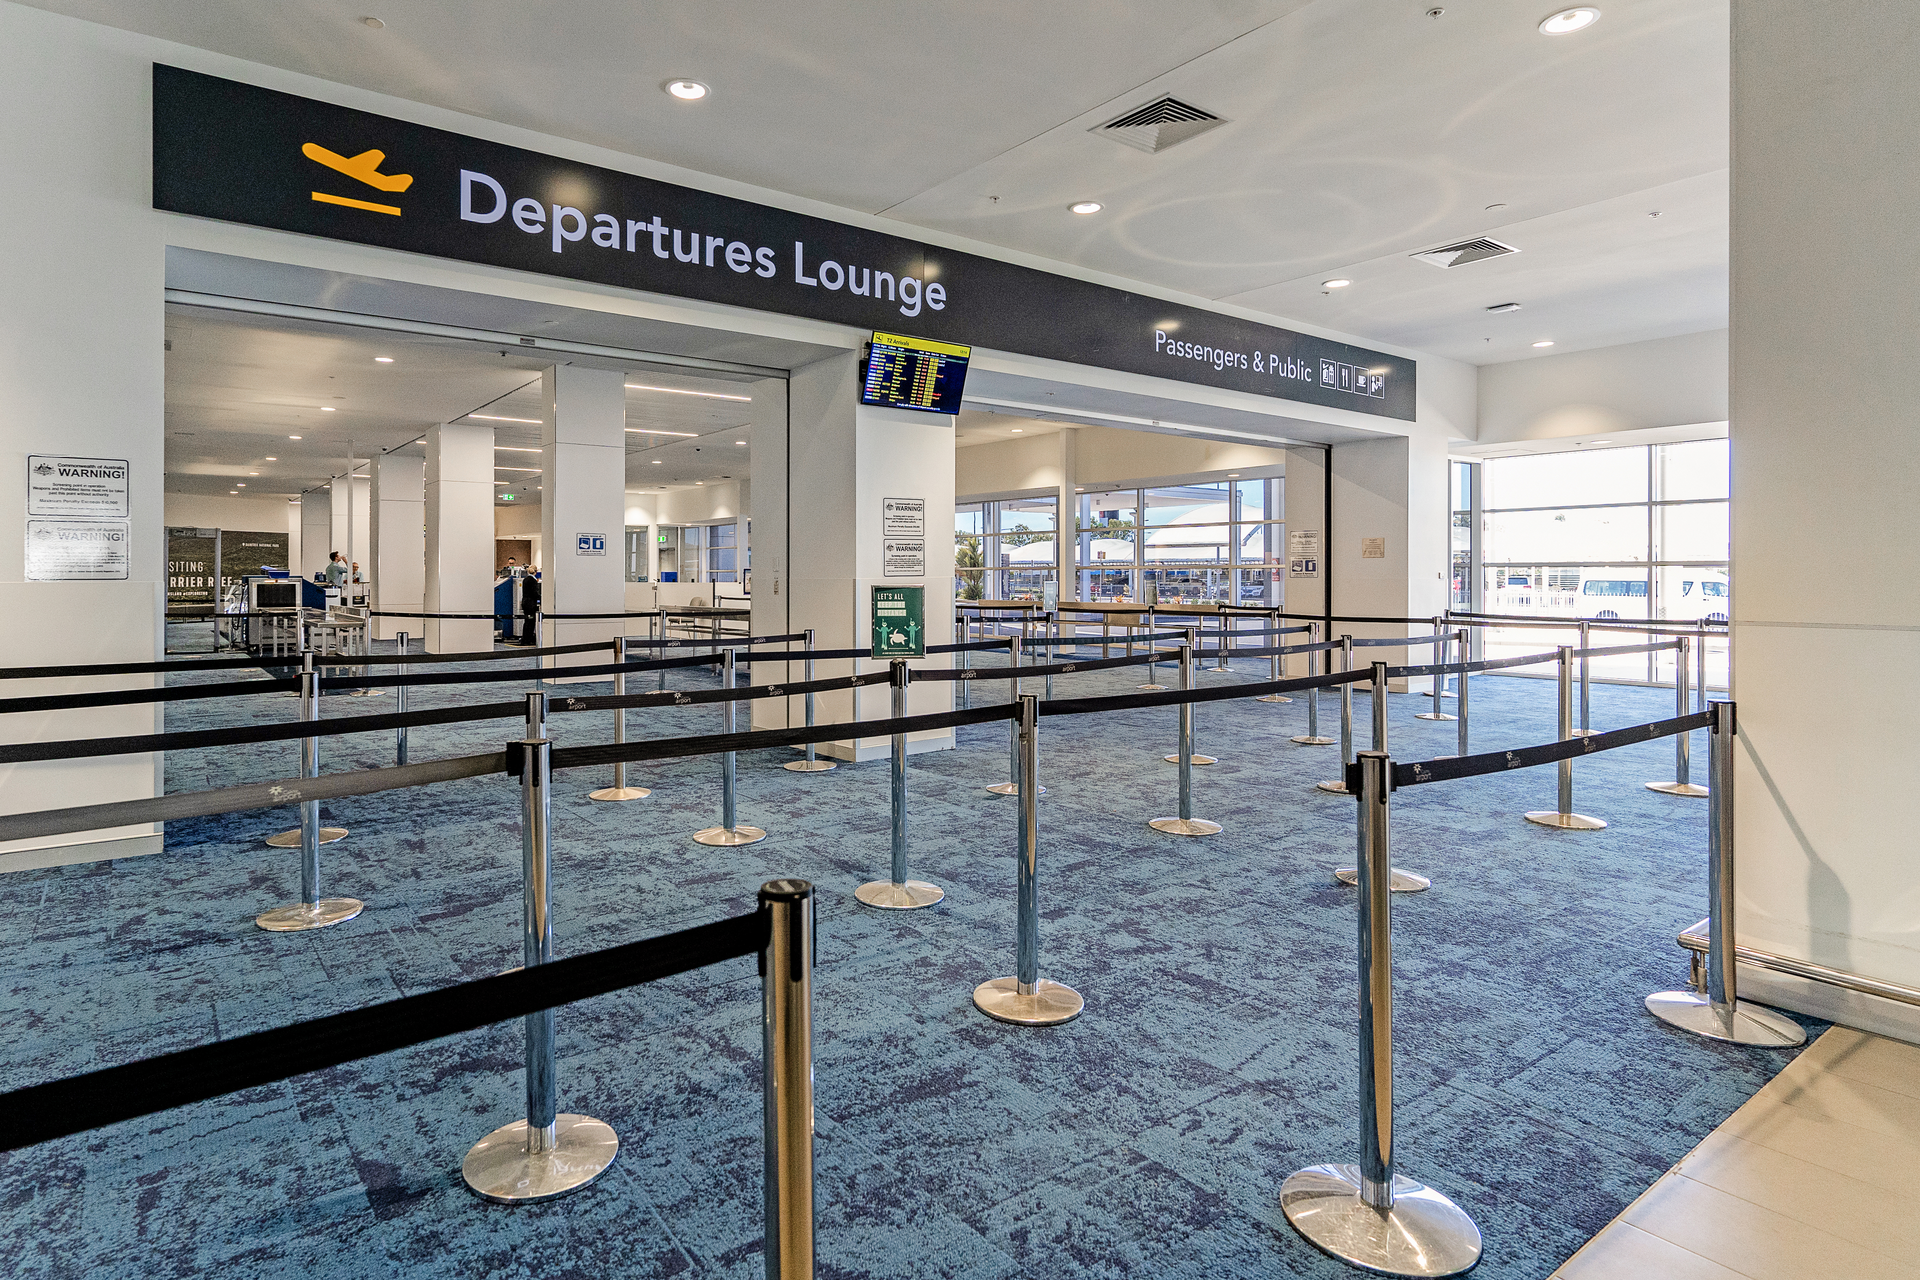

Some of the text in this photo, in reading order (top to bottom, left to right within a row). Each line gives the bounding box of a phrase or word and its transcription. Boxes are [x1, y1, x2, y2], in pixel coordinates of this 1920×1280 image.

[460, 168, 947, 317] Departures Lounge
[892, 338, 910, 346] Arrivals
[1155, 329, 1312, 382] Passengers & Public
[58, 468, 125, 479] WARNING!
[58, 532, 125, 542] WARNING!
[168, 576, 232, 588] RRIER REF
[960, 671, 977, 679] airport
